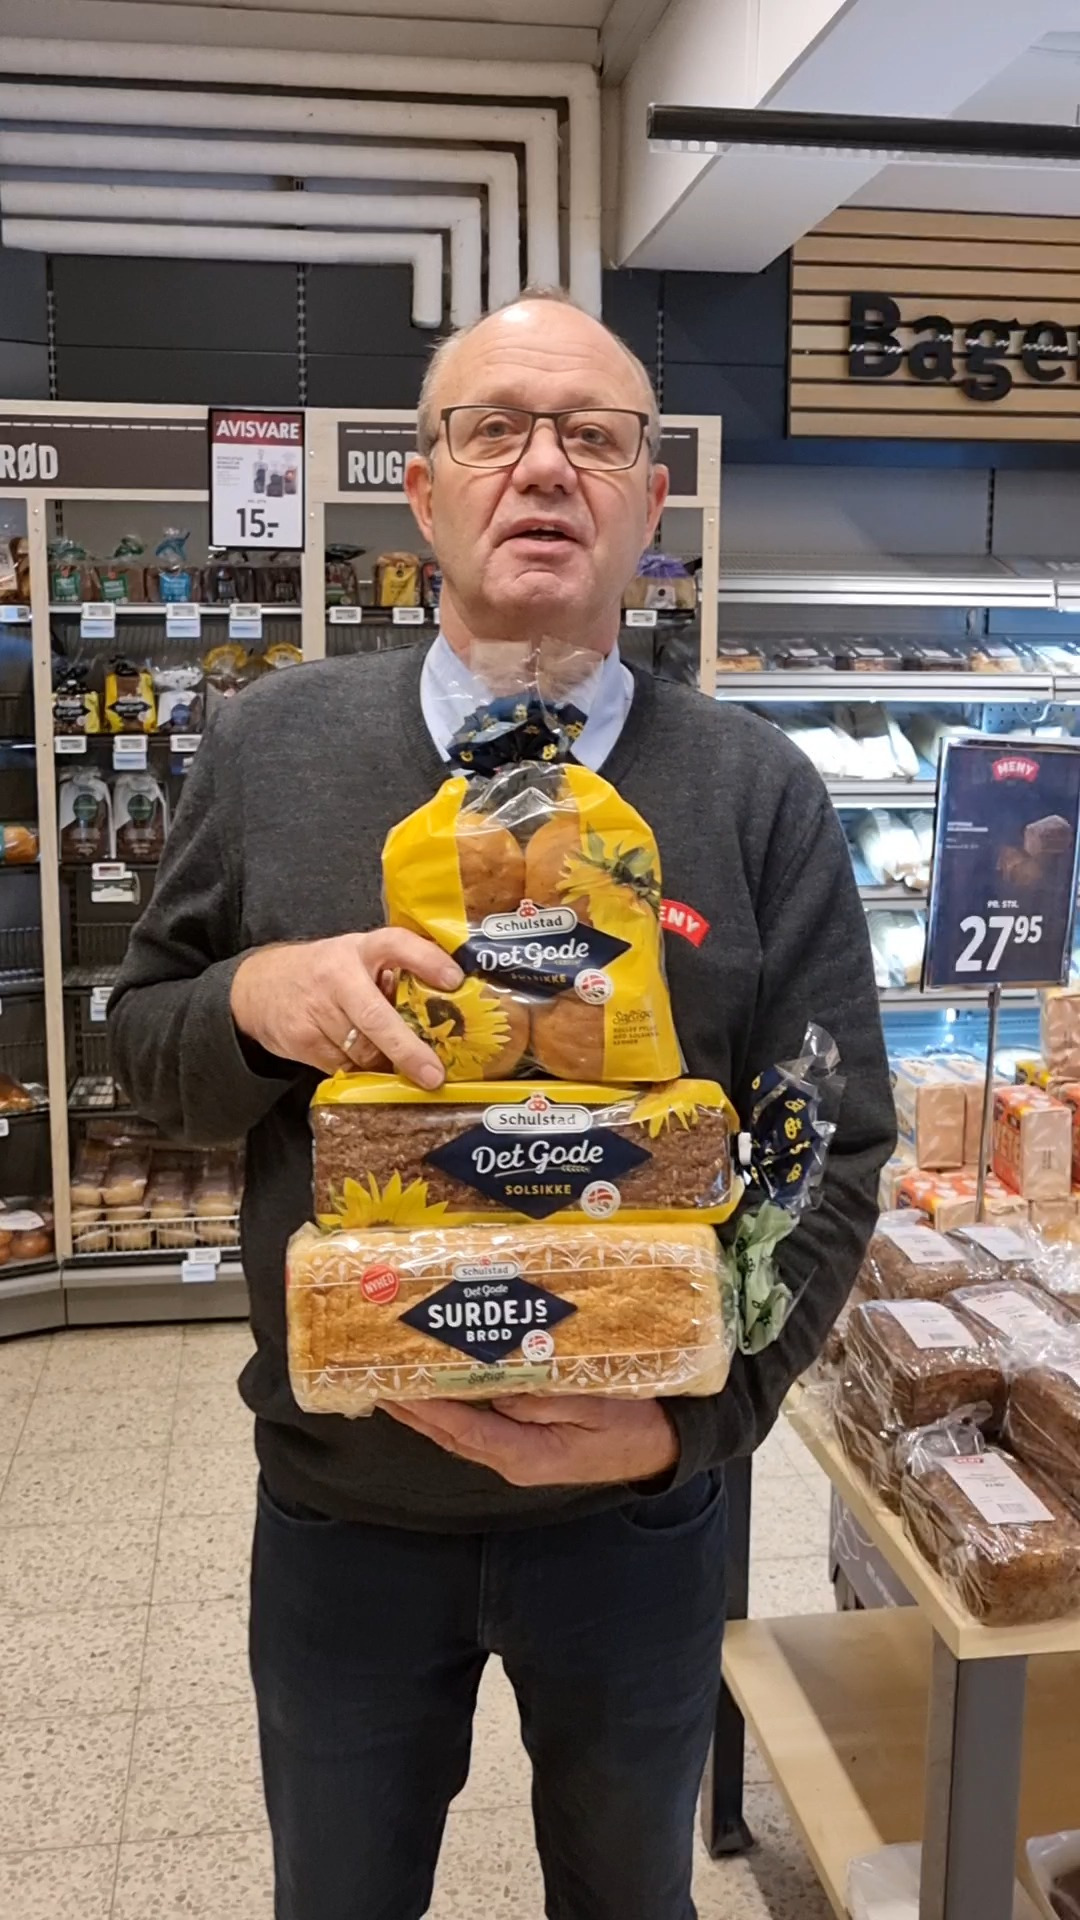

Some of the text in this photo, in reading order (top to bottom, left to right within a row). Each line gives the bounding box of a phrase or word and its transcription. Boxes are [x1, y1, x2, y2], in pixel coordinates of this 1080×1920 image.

[848, 292, 1080, 402] Bage
[216, 419, 299, 440] AVISVARE
[998, 760, 1034, 776] MENY
[495, 916, 563, 932] Schulstad
[476, 938, 589, 971] Det Gode
[499, 1113, 576, 1126] Schulstad
[472, 1139, 604, 1174] Det Gode
[505, 1184, 572, 1196] SOLSIKKE
[364, 1277, 396, 1295] NYHED
